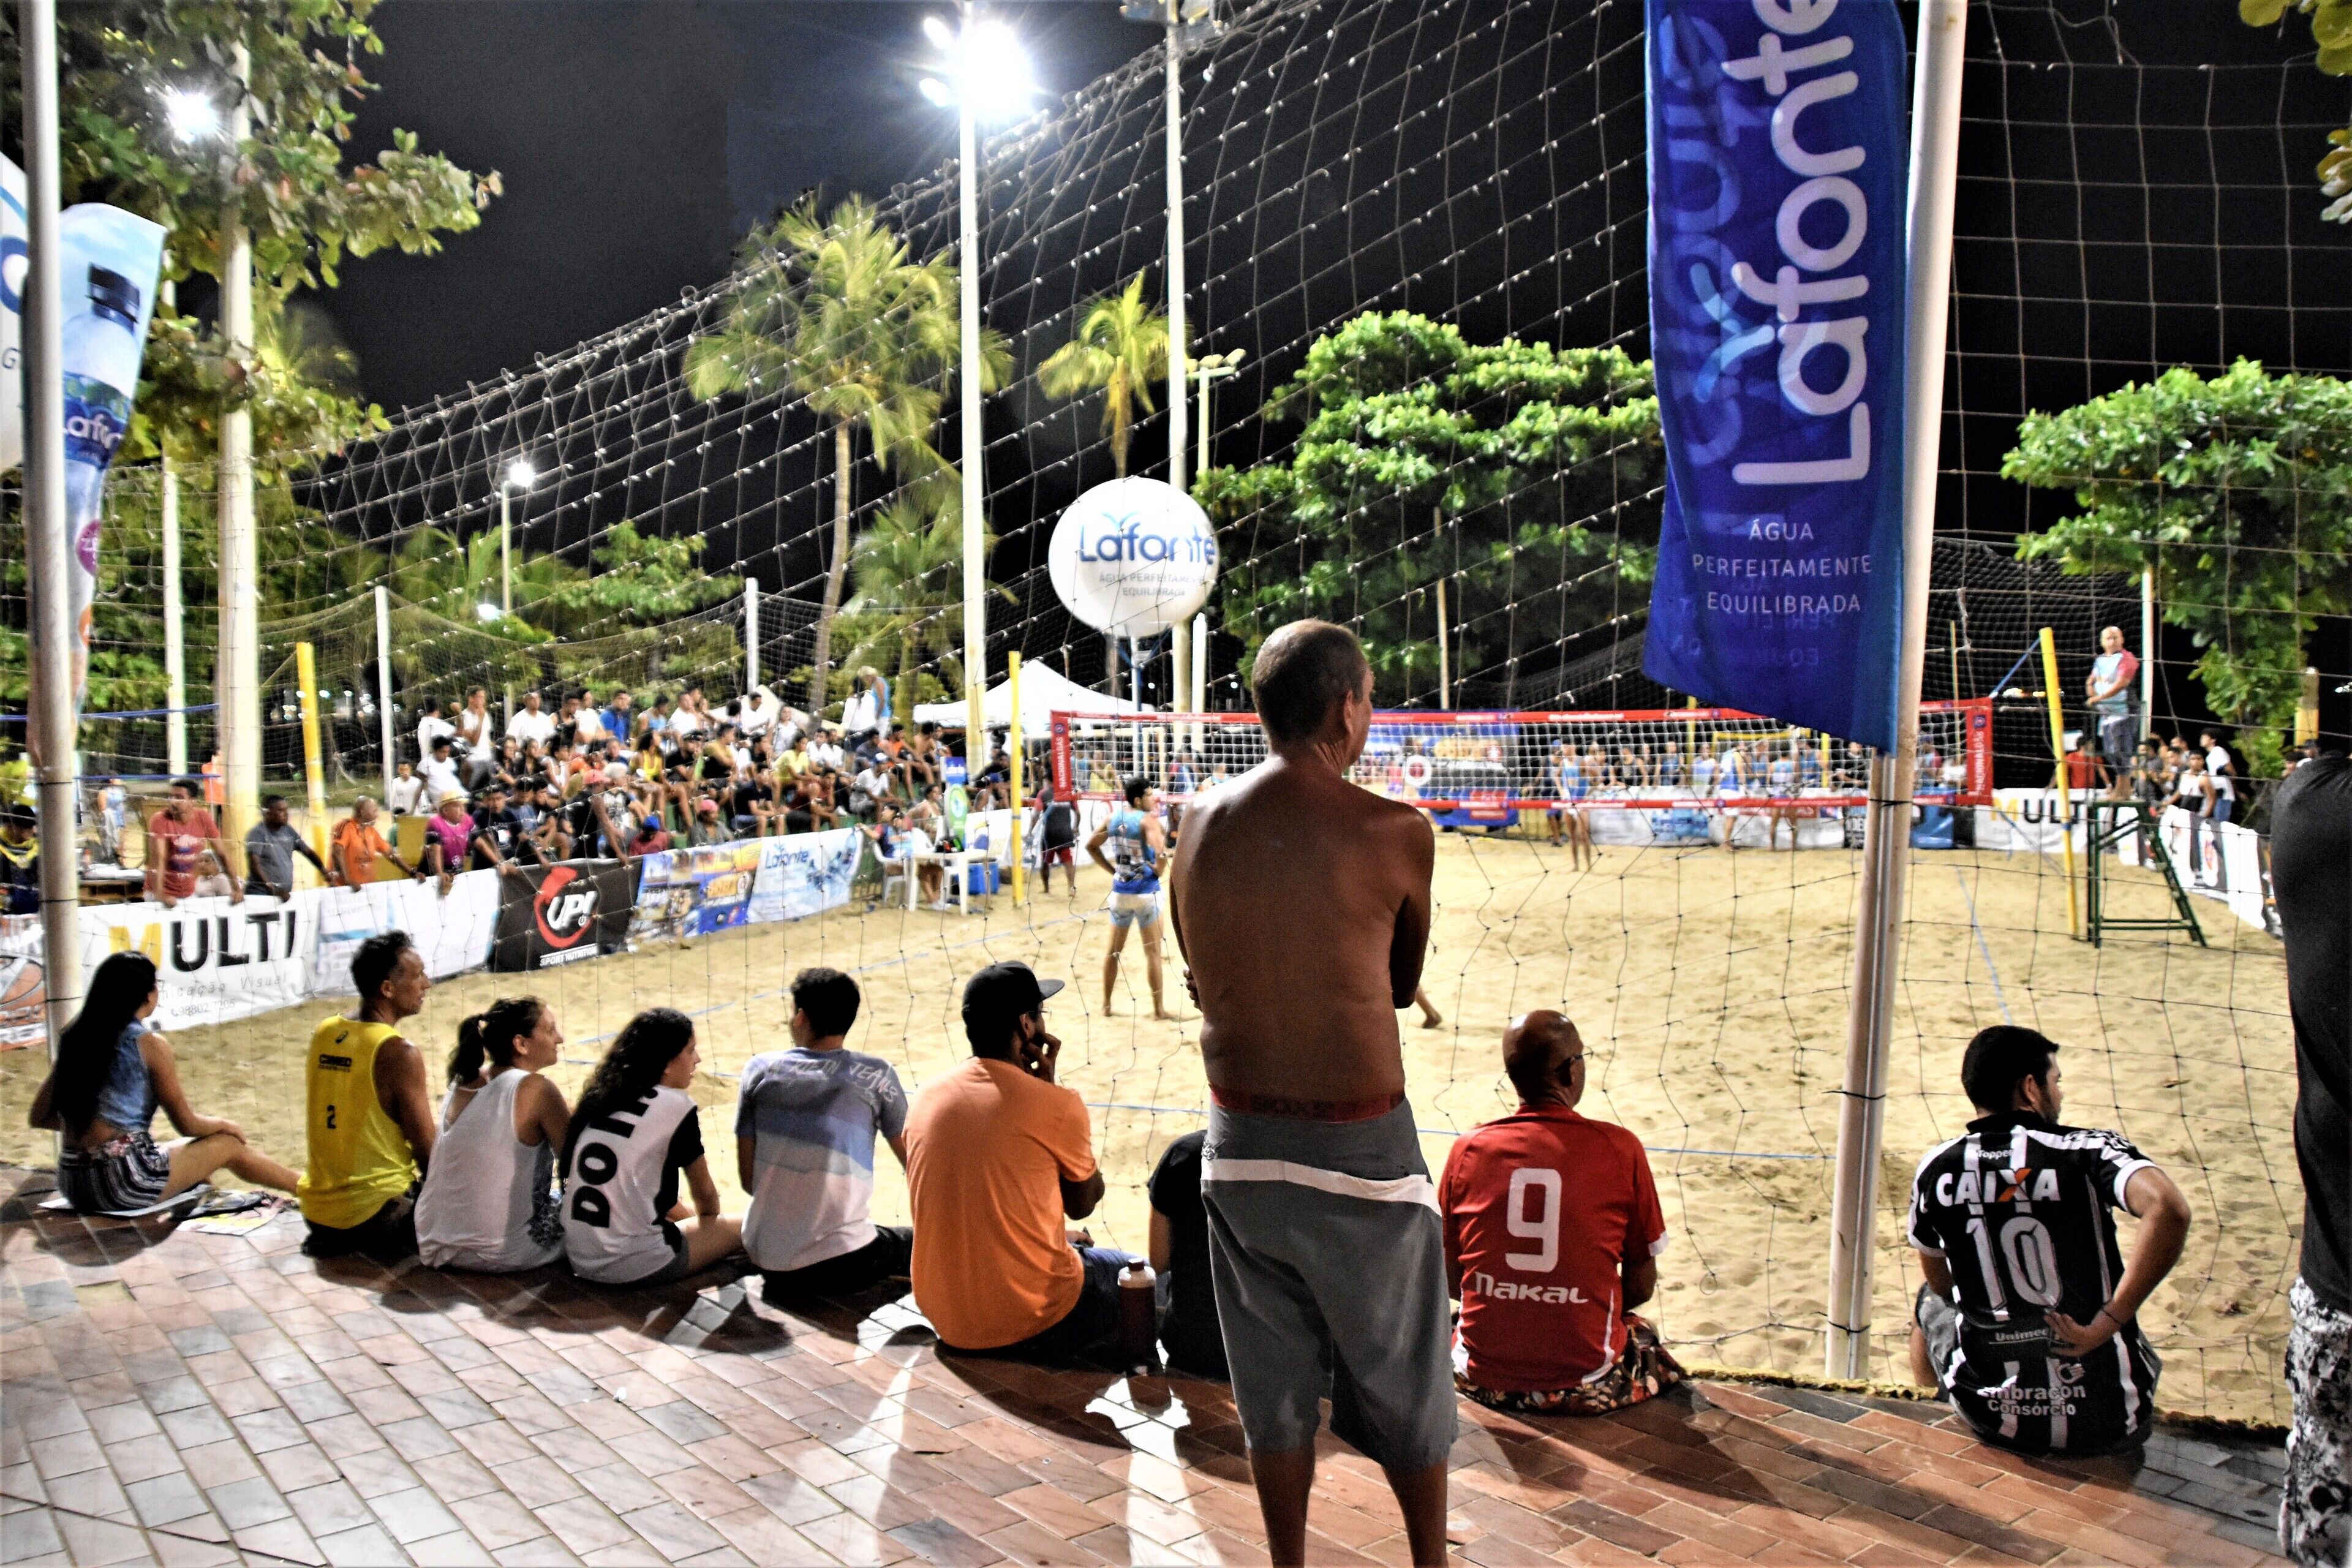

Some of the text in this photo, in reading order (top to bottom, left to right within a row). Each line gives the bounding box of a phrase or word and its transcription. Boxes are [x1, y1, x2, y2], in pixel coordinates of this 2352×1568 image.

[1749, 518, 1814, 541] ÁGUA
[1079, 521, 1216, 566] Lafonte
[1692, 554, 1872, 577] PERFEITAMENTE
[1706, 591, 1861, 614] EQUILIBRADA
[1990, 798, 2084, 824] MULT
[547, 891, 598, 930] UP!
[108, 910, 296, 973] MULTI
[540, 954, 565, 967] SPORT
[326, 1104, 336, 1129] 2
[1936, 1167, 2061, 1207] CAIXA
[1505, 1167, 1562, 1273] 9
[1966, 1215, 2064, 1310] 10
[1988, 1399, 2076, 1416] Consórcio
